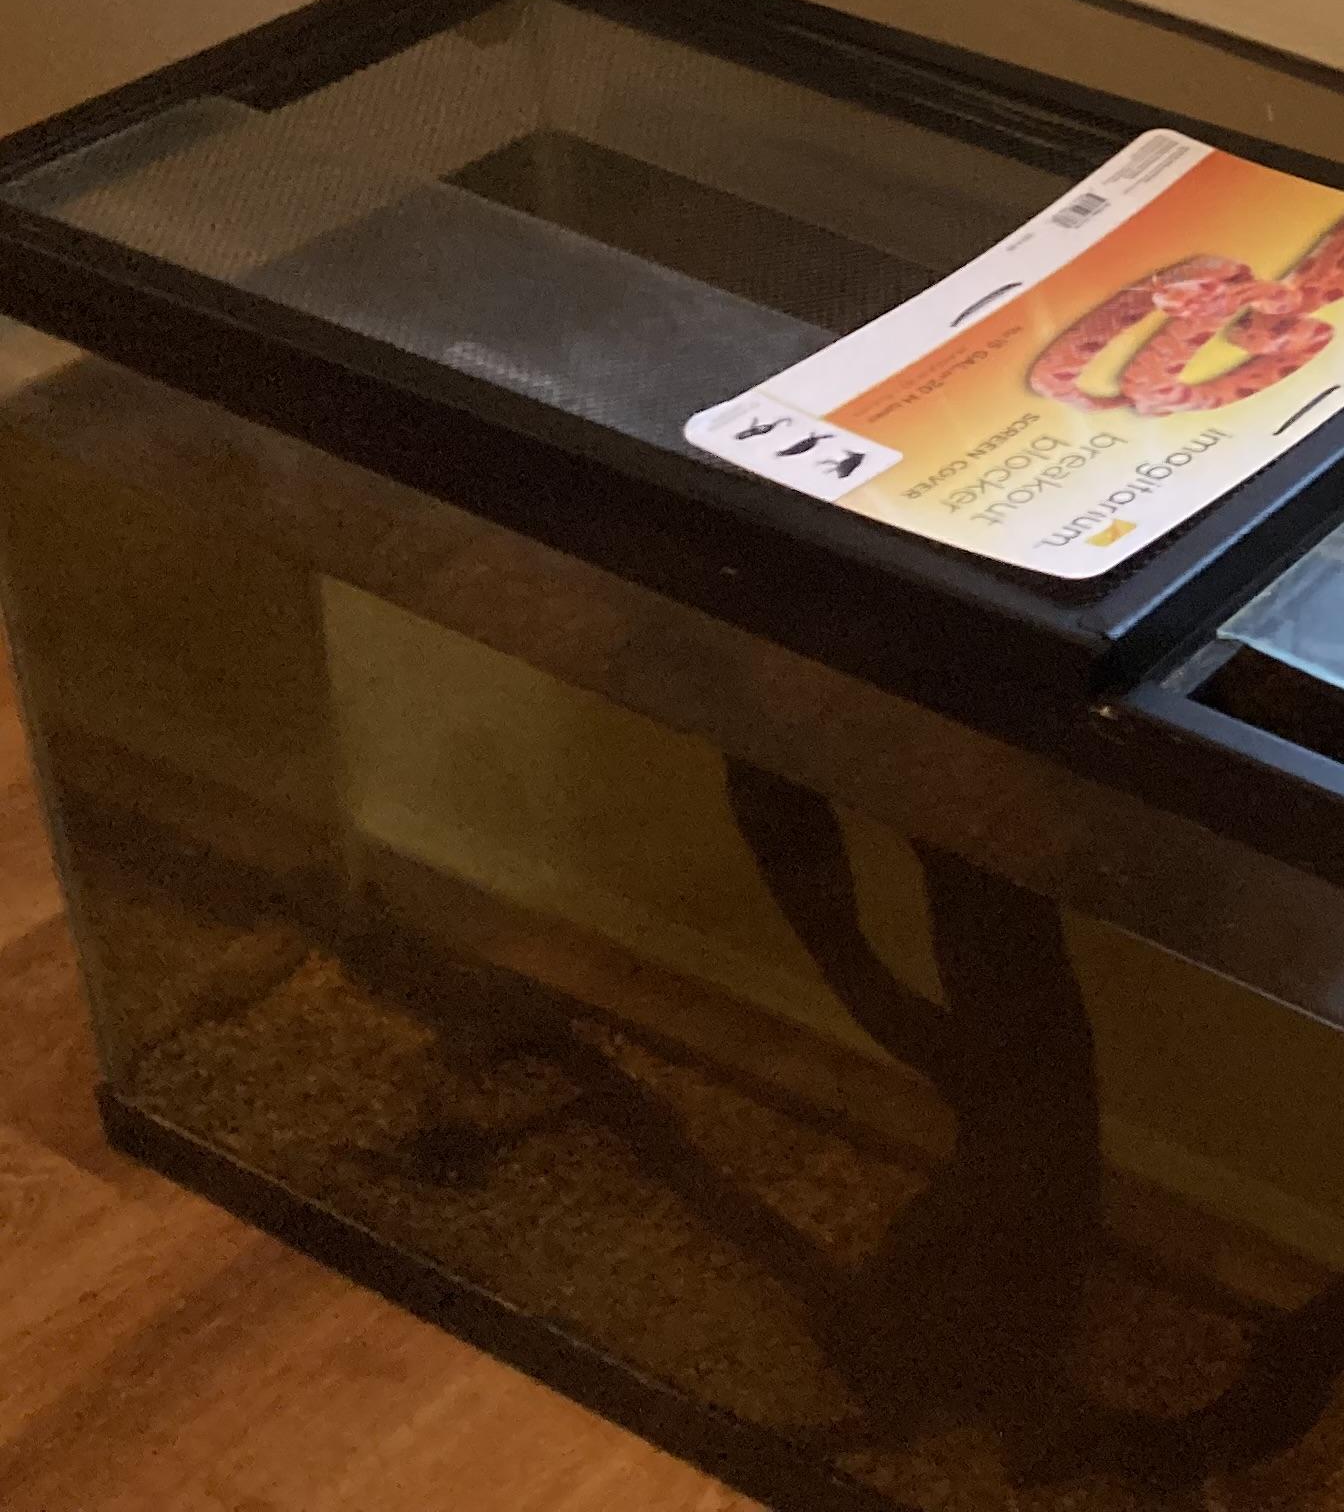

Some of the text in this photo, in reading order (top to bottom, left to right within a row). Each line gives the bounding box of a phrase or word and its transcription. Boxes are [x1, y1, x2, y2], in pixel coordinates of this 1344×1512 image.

[904, 413, 1040, 499] SCREEN COVER
[940, 436, 1069, 514] blocker
[971, 431, 1128, 526] breakout
[1042, 427, 1234, 548] imagitarium
